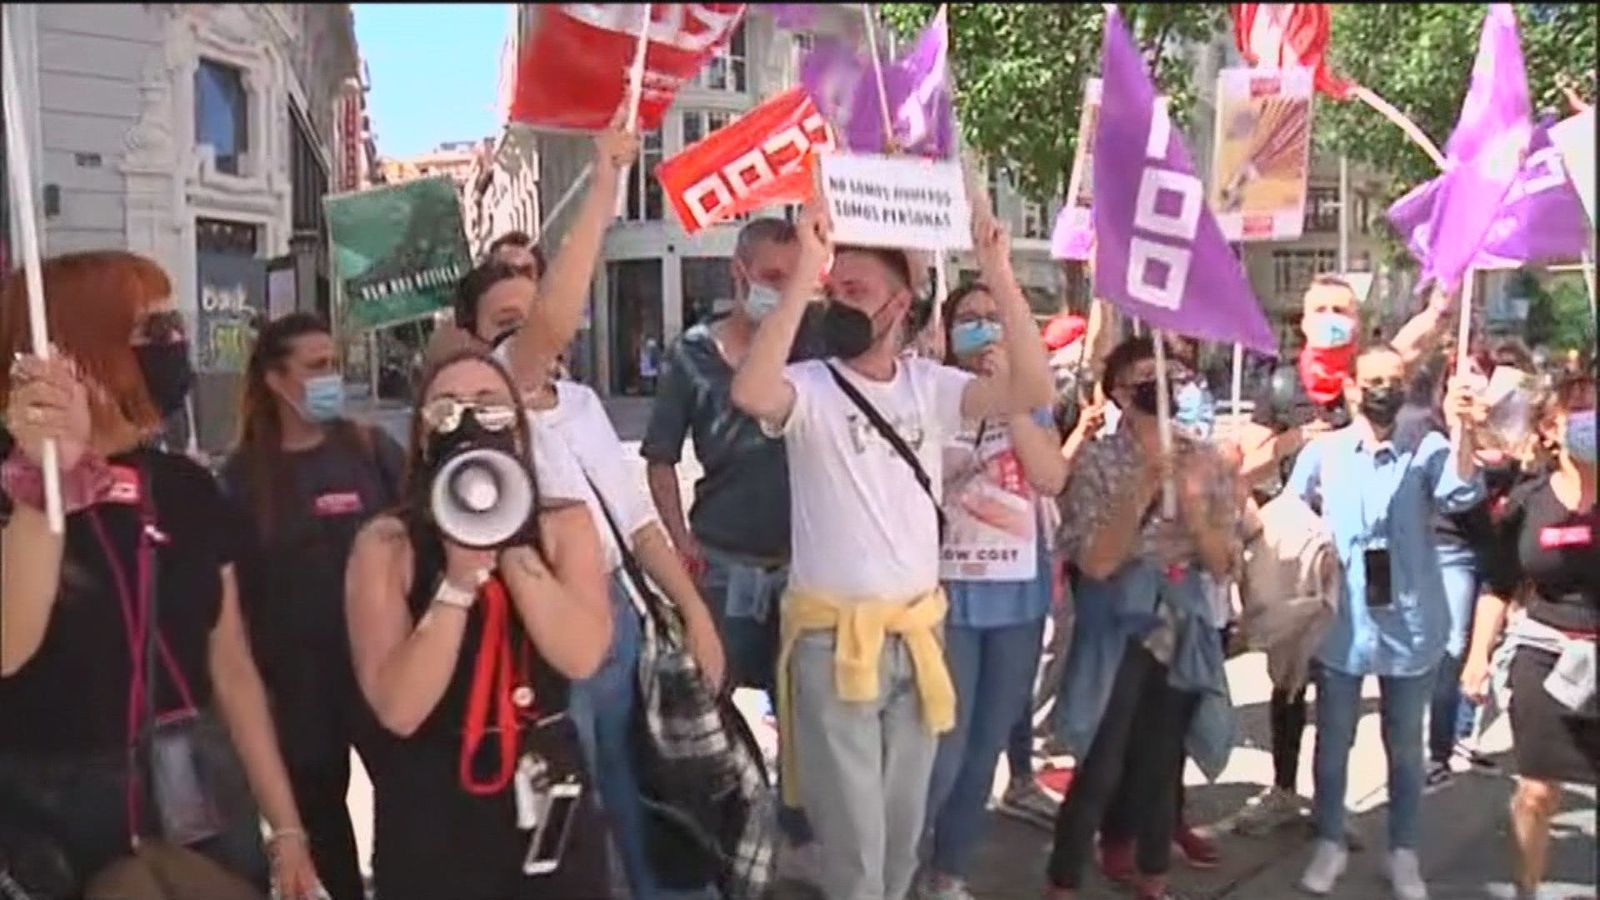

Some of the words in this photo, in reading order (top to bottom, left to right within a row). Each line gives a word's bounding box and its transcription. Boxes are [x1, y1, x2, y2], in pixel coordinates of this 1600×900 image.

[829, 176, 846, 192] NO
[850, 180, 889, 201] SOMOS
[834, 200, 879, 222] SOMOS
[882, 208, 951, 226] PERSONAS
[976, 548, 1018, 562] COST
